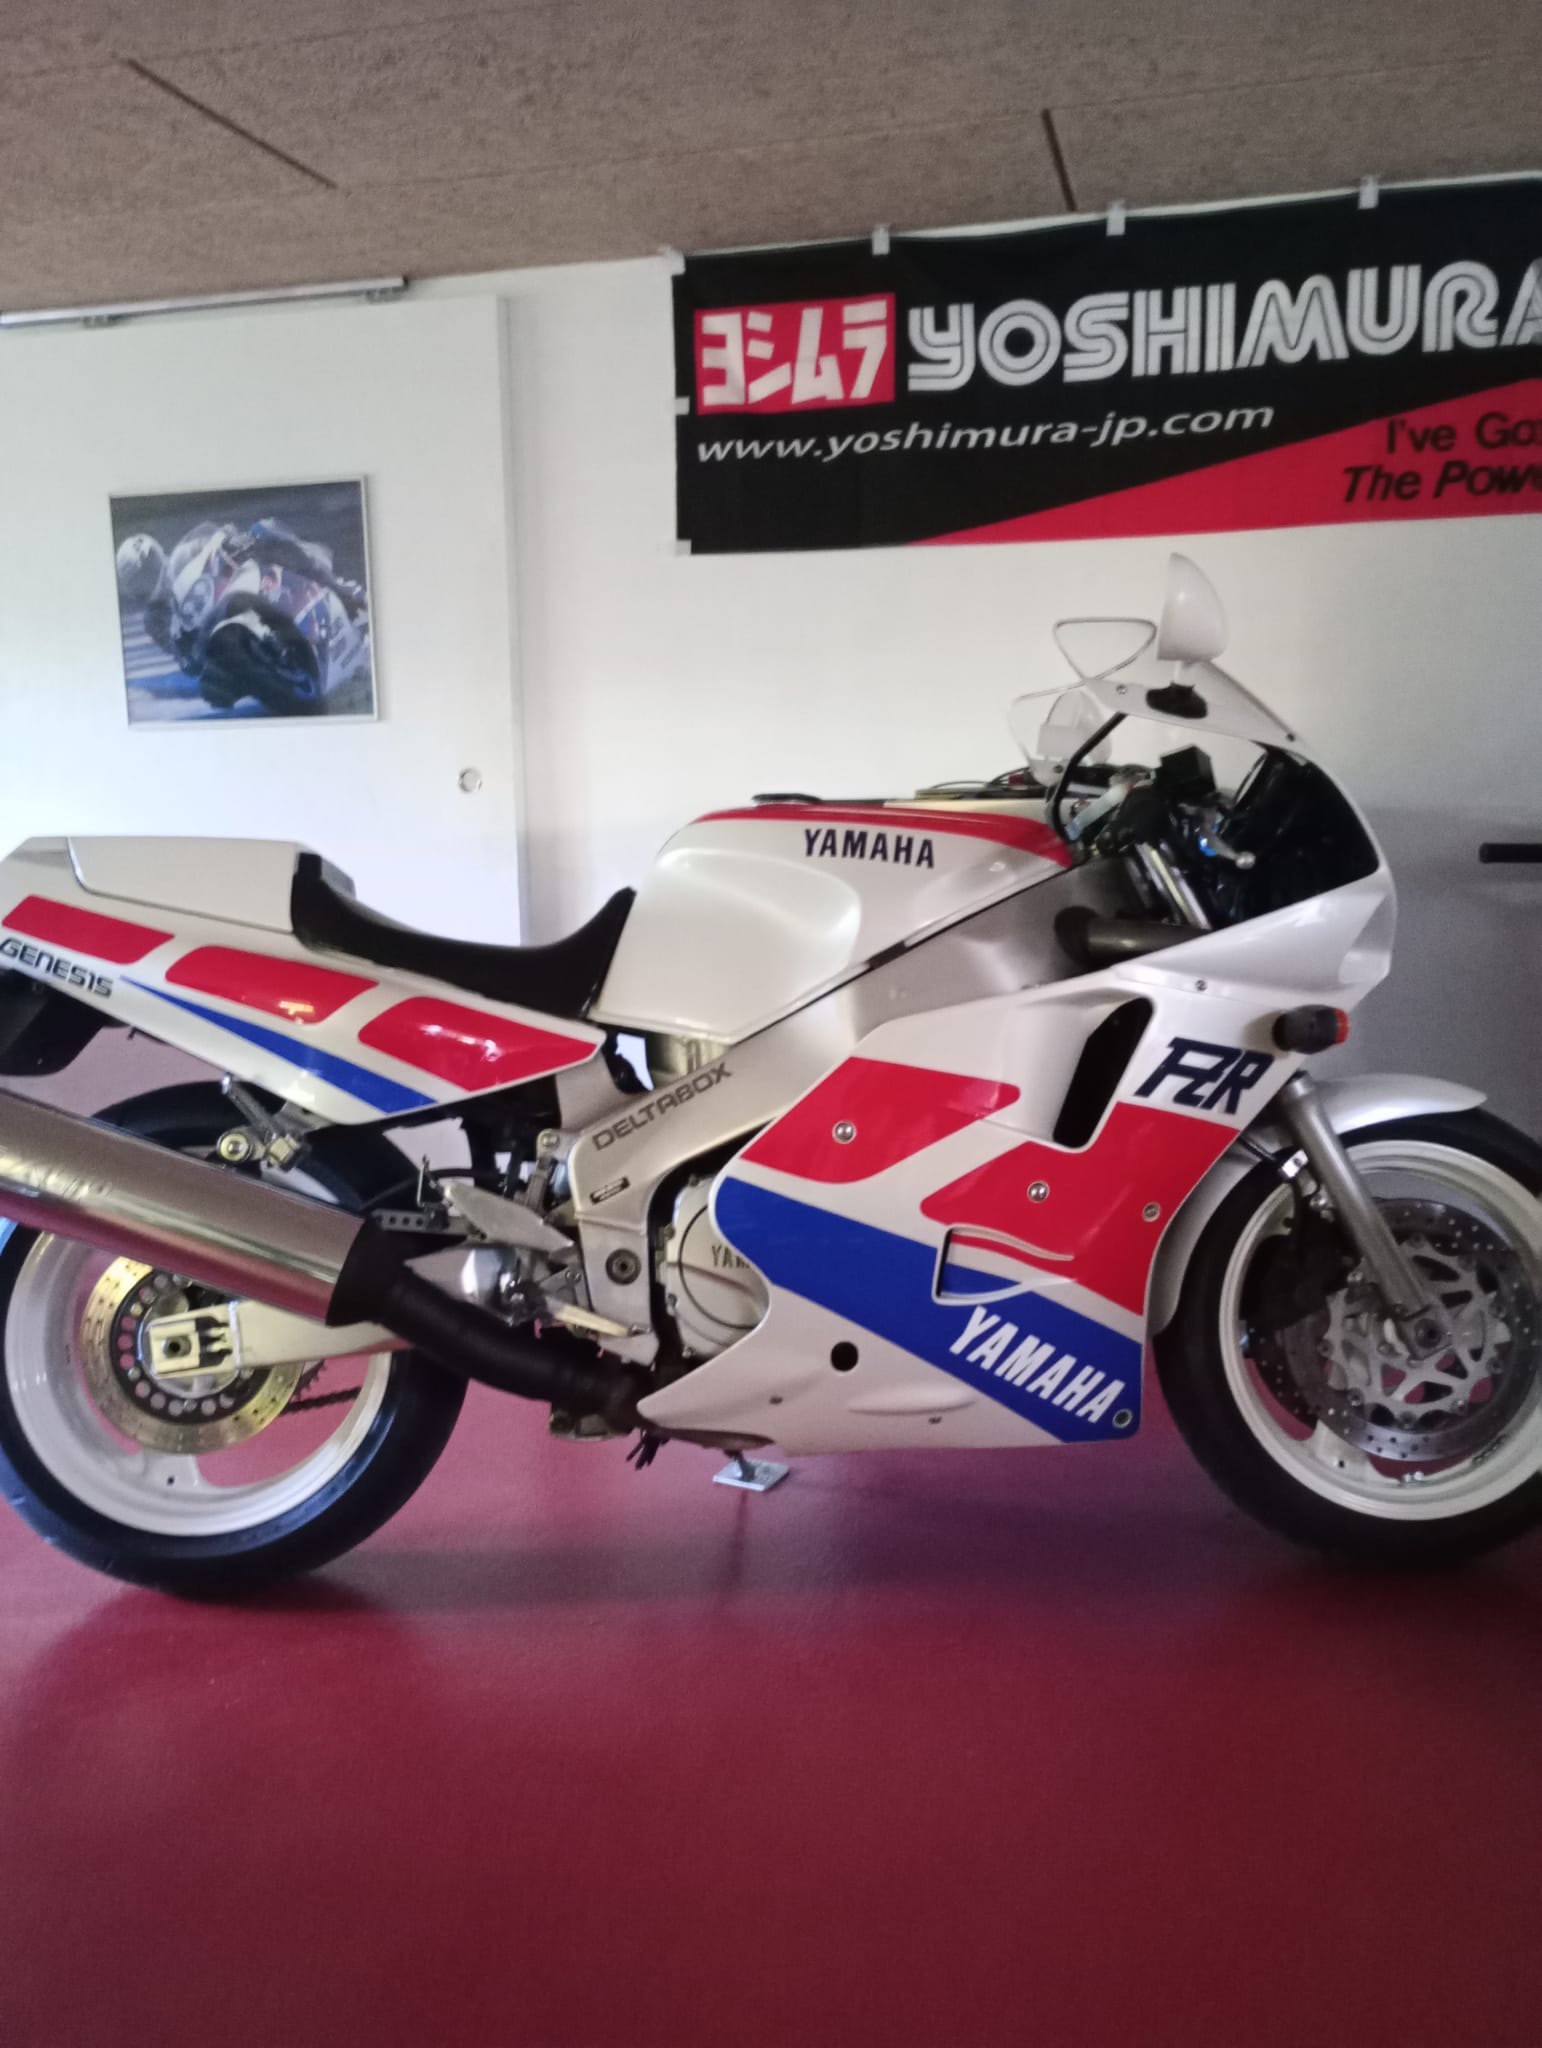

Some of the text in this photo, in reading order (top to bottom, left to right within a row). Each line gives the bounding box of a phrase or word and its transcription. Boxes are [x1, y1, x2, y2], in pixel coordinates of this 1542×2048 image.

[702, 299, 888, 406] ヨシムラ
[697, 406, 1275, 463] www.yoshimura-jp.com
[1385, 418, 1457, 454] I've
[1343, 465, 1422, 503] The
[804, 828, 934, 869] YAMAHA
[592, 1061, 732, 1152] DELTABOX
[1133, 1036, 1275, 1115] FZR
[949, 1304, 1126, 1424] YAMAHA
